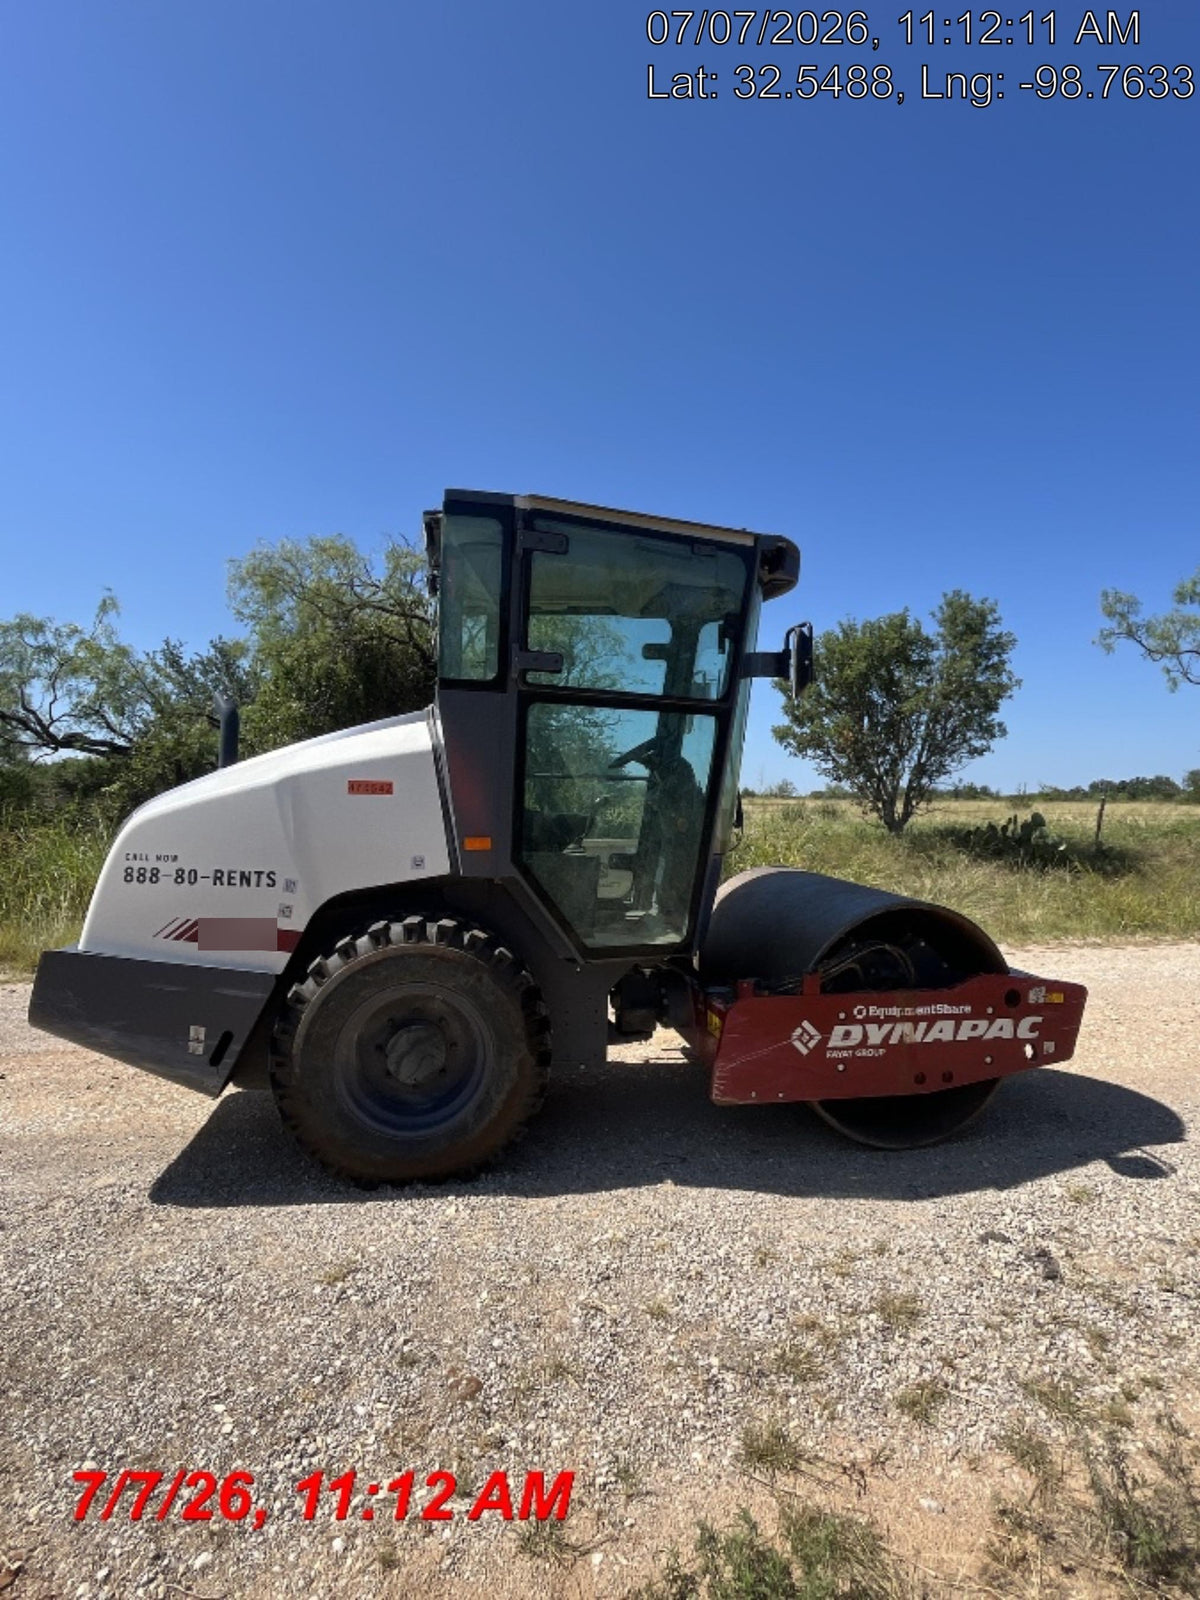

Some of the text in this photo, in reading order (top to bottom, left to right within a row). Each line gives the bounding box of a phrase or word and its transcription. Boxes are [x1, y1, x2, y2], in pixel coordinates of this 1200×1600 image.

[125, 853, 178, 863] CALL NOW
[123, 866, 276, 888] 888-80-RENTS
[868, 1004, 972, 1019] EquipmentShare
[826, 1016, 1043, 1048] DYNAPAC
[826, 1049, 886, 1058] FAYAT GROUP
